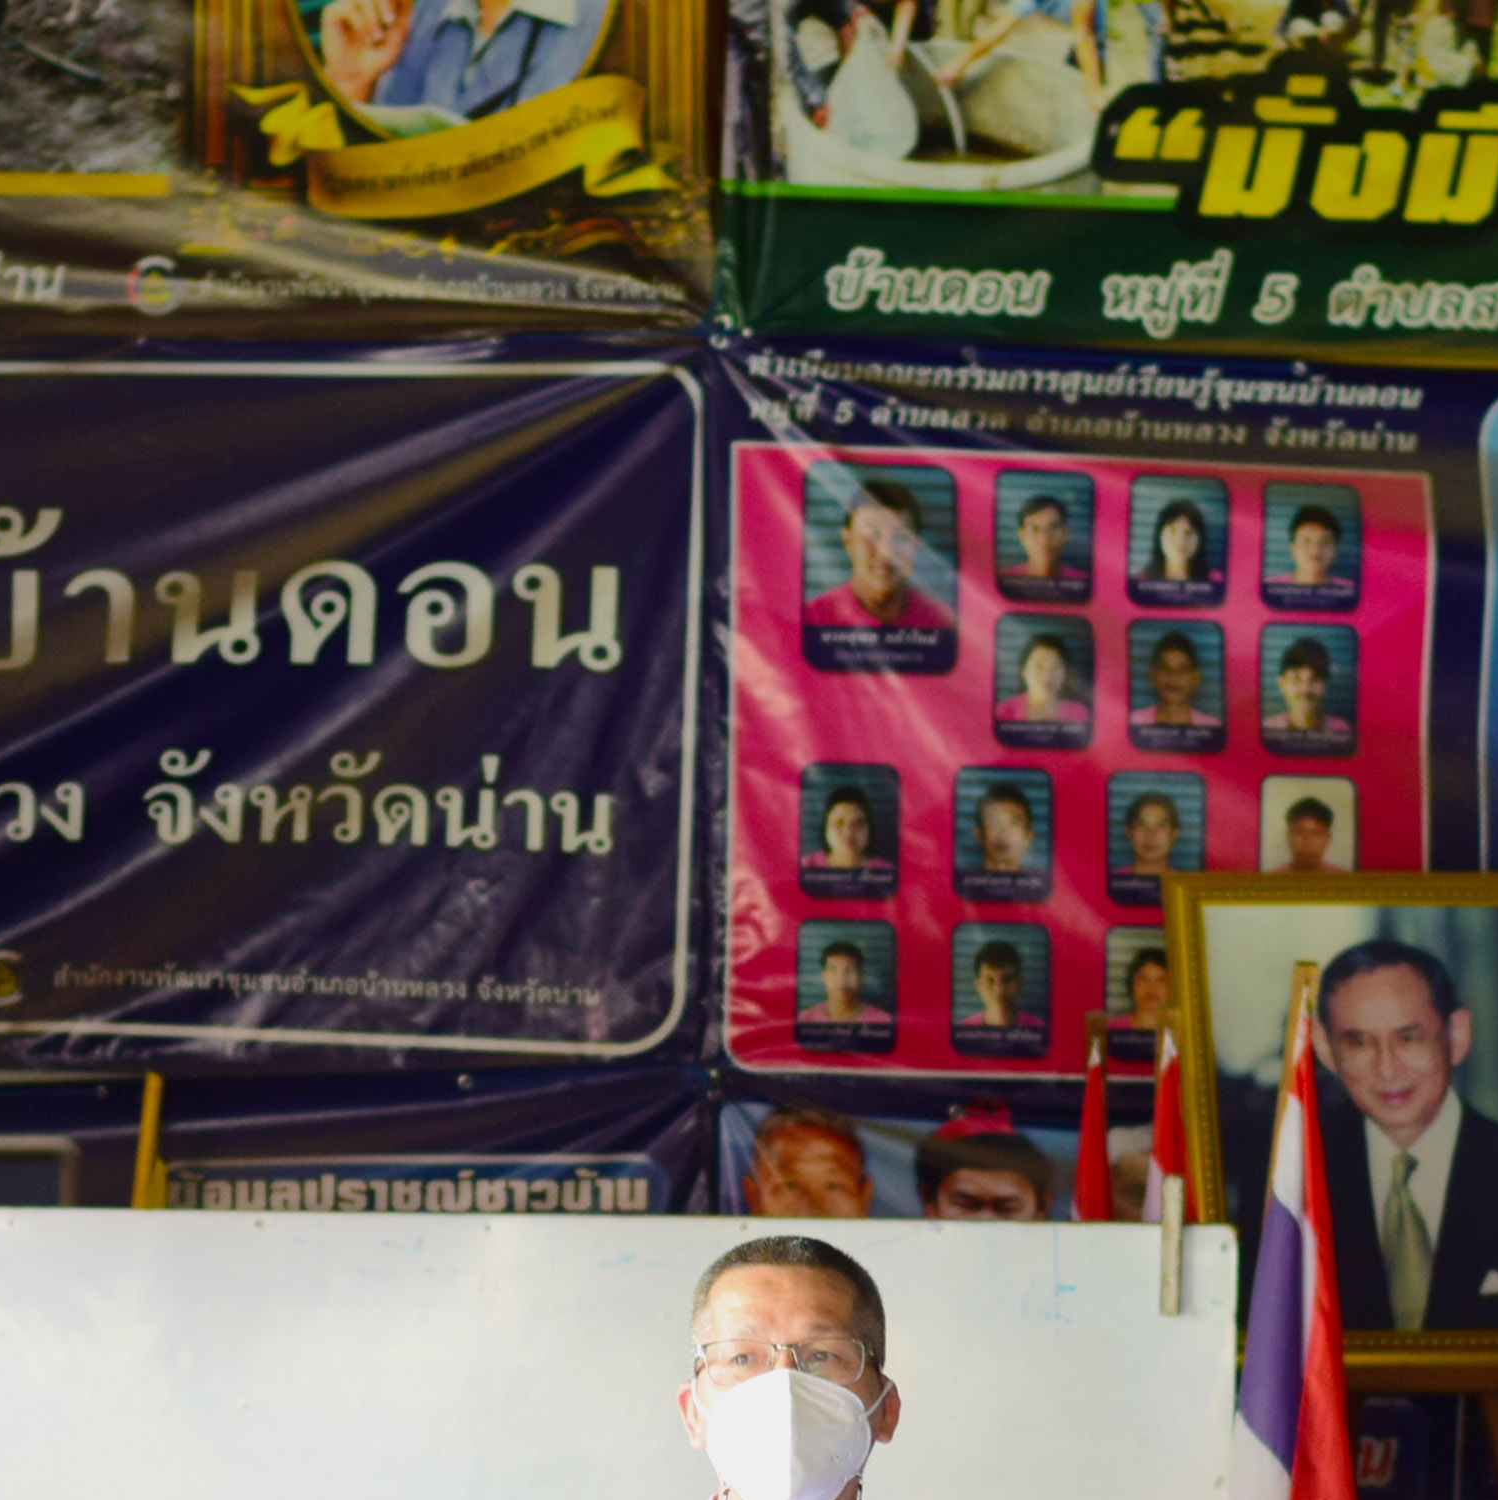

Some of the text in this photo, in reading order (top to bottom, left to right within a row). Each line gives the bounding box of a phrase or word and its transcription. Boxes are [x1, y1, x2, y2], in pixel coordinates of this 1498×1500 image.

[825, 246, 1050, 318] บ้านดอน
[1100, 249, 1232, 338] หมู่ที่
[1250, 271, 1298, 327] 5
[834, 399, 856, 425] 5
[144, 746, 615, 854] จังหวัดน่าน
